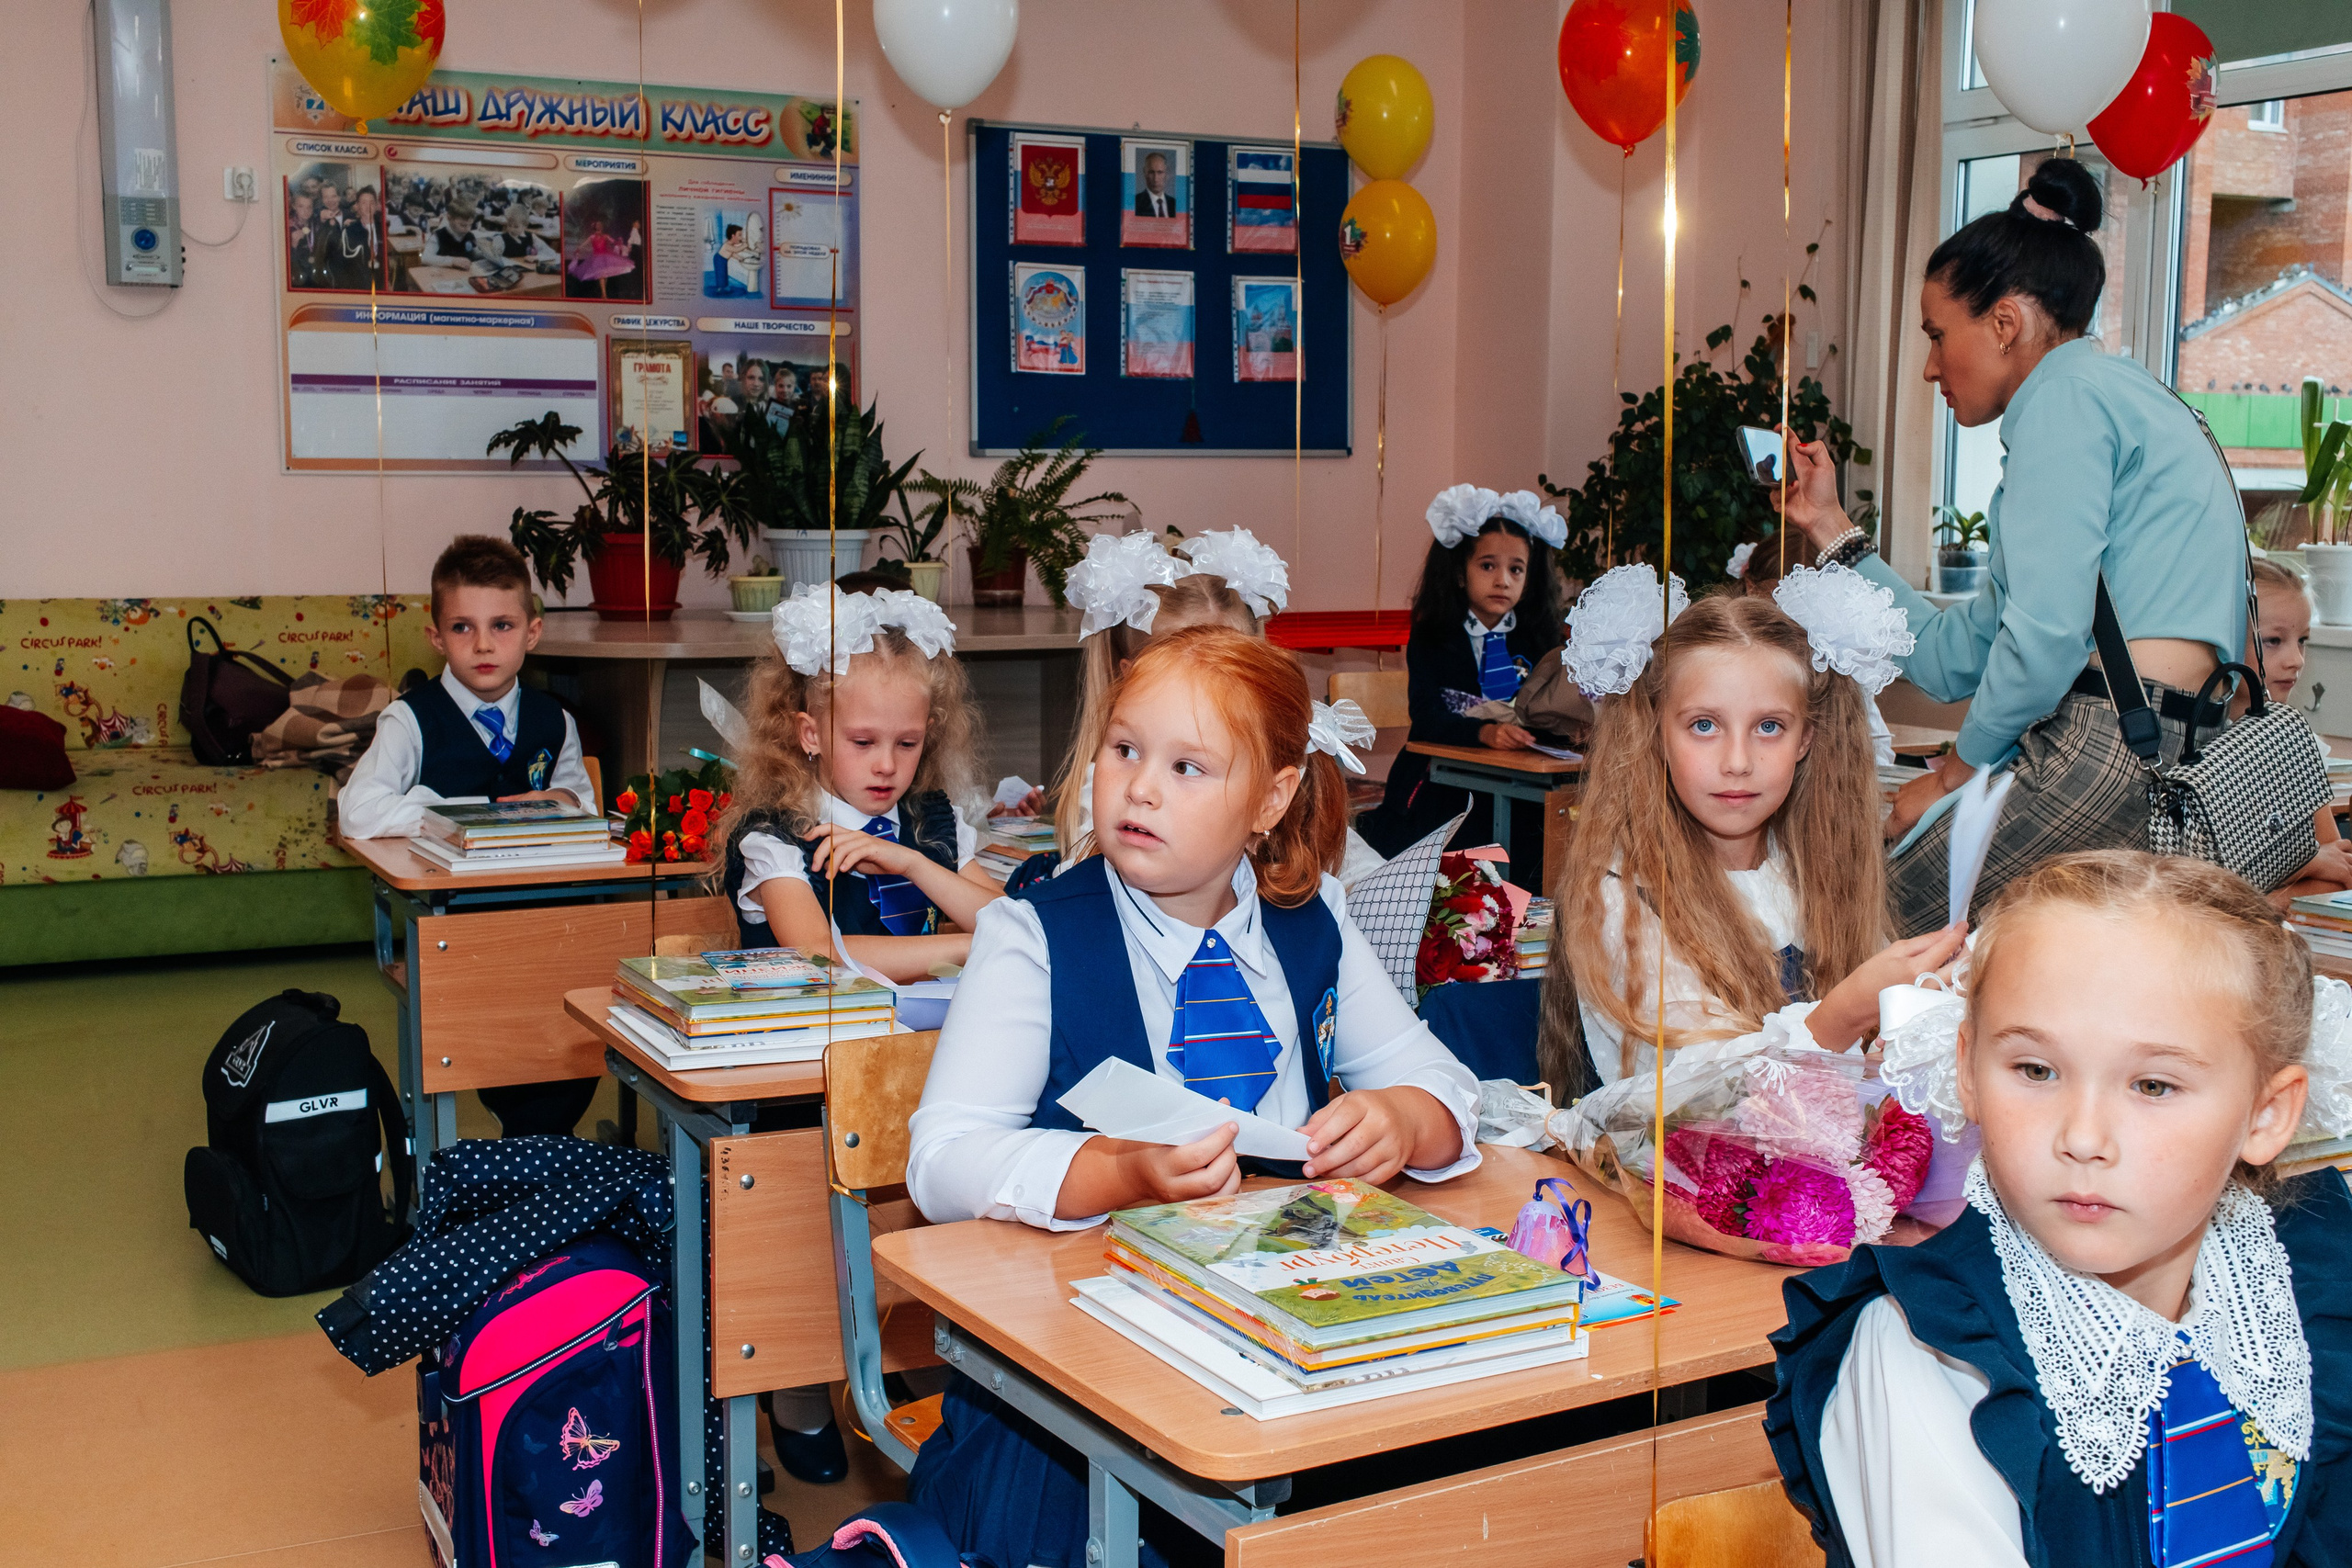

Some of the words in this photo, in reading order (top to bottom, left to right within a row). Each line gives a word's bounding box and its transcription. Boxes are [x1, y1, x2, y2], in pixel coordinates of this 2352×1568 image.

[397, 88, 462, 119] АШ
[476, 87, 642, 132] ДРУЖНЫЙ
[659, 100, 766, 138] КЛАСС
[296, 141, 333, 153] СПИСОК
[334, 144, 368, 155] КЛАССА
[575, 159, 637, 171] МЕРОПРИЯТИЯ
[355, 310, 427, 322] ИНФОРМАЦИЯ
[429, 312, 536, 328] (магнитно-маркерная)
[613, 316, 642, 327] ГРАФИК
[734, 321, 760, 331] НАШЕ
[761, 321, 816, 333] ТВОРЧЕСТВО
[20, 636, 67, 649] CIRCUS
[67, 636, 102, 649] PARK!
[277, 630, 321, 643] CIRCUS
[321, 629, 354, 642] PARK!
[131, 783, 179, 796] CIRCUS
[180, 783, 218, 795] PARK!
[299, 1097, 339, 1113] GLVR
[1278, 1235, 1464, 1272] Петербург
